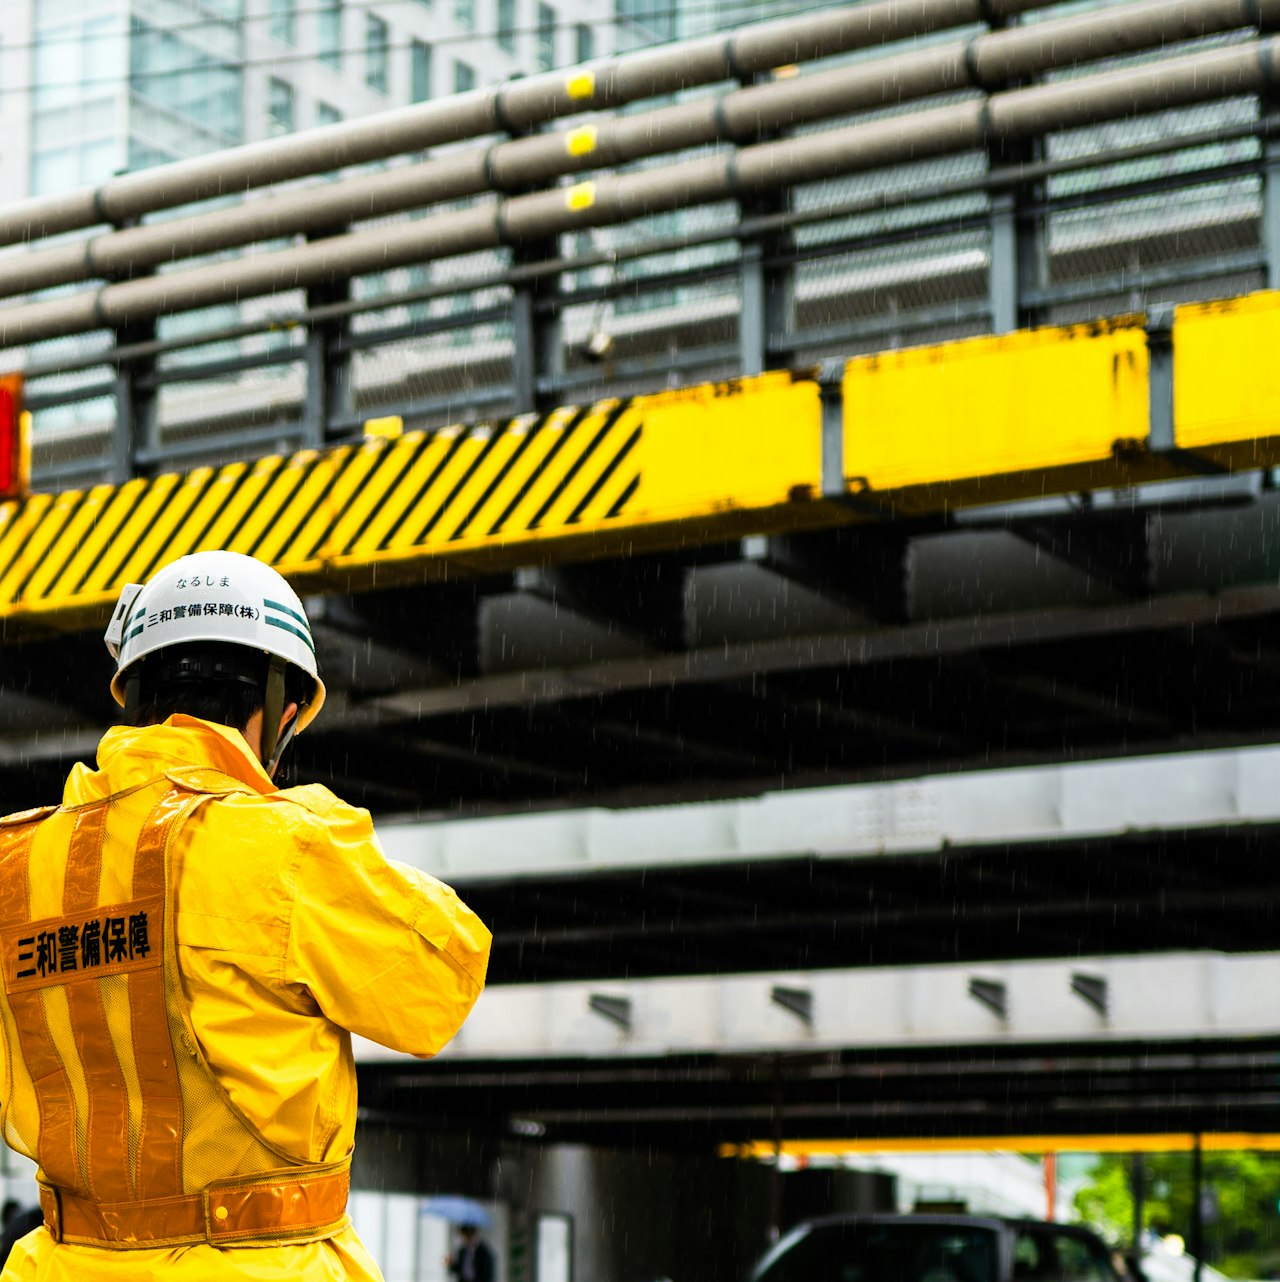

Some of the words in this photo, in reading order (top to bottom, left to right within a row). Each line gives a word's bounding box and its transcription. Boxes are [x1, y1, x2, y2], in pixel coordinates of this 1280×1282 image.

[176, 575, 230, 589] なるしま
[147, 603, 260, 628] 三和警備保障(株)
[16, 911, 151, 979] 三和警備保障
